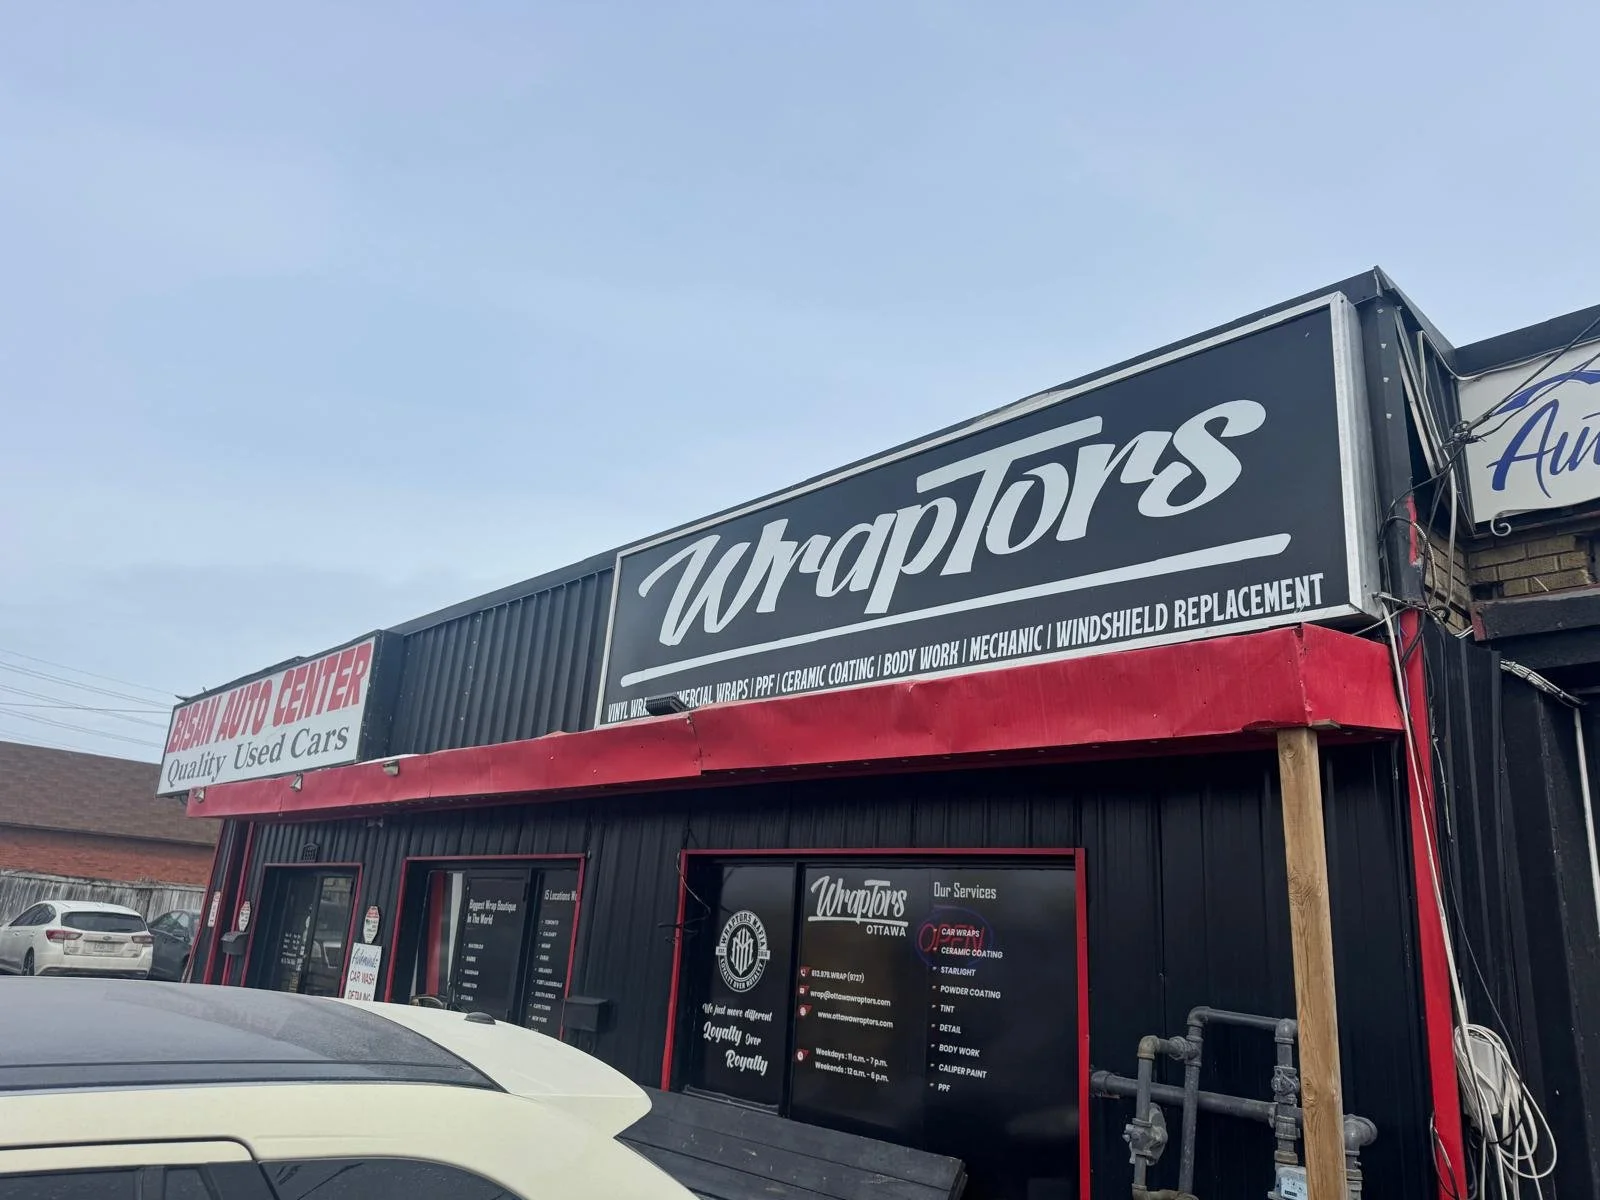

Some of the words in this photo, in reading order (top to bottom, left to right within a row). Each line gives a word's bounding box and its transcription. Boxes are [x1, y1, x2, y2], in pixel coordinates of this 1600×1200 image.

[608, 701, 628, 722] VINYL
[717, 678, 749, 704] WRAPS
[755, 674, 775, 698] PPF
[782, 665, 826, 693] CERAMIC
[828, 656, 874, 685] COATING
[884, 648, 917, 677] BODY
[920, 640, 960, 670] WORK
[969, 625, 1044, 662] MECHANIC
[1056, 603, 1168, 648] WINDSHIELD
[1174, 573, 1324, 628] REPLACEMENT
[167, 696, 222, 754] BISAN
[215, 679, 273, 743] AUTO
[273, 642, 372, 727] CENTER
[167, 751, 227, 788] Quality
[234, 733, 286, 770] Used
[291, 726, 350, 760] Cars
[934, 882, 951, 898] Our
[954, 882, 997, 900] Services
[470, 899, 486, 912] Biggest
[486, 899, 497, 912] Wrap
[497, 900, 517, 914] Boutique
[472, 913, 480, 924] The
[480, 914, 494, 925] World
[721, 913, 752, 944] WRAPTORS
[866, 925, 906, 936] OTTAWA
[942, 928, 956, 936] CAR
[956, 929, 980, 938] WRAPS
[919, 924, 986, 952] OPEN
[941, 947, 970, 956] CERAMIC
[972, 950, 1003, 958] COATING
[941, 966, 976, 976] STARLIGHT
[810, 991, 891, 1006] wrap@ottawawraptors.com
[941, 985, 969, 996] POWDER
[970, 989, 1001, 999] COATING
[713, 1005, 726, 1016] just
[727, 1008, 743, 1018] more
[745, 1009, 772, 1022] different
[940, 1005, 955, 1014] TINT
[818, 1011, 894, 1028] www.ottawawraptors.com
[703, 1021, 742, 1046] Loyalty
[745, 1033, 762, 1046] Over
[940, 1024, 962, 1034] DETAIL
[816, 1048, 845, 1060] Weekdays
[939, 1044, 958, 1054] BODY
[959, 1047, 980, 1058] WORK
[725, 1049, 769, 1076] Royalty
[815, 1061, 844, 1074] Weekends
[939, 1064, 966, 1076] CALIPER
[966, 1067, 988, 1079] PAINT
[938, 1083, 950, 1093] PPF
